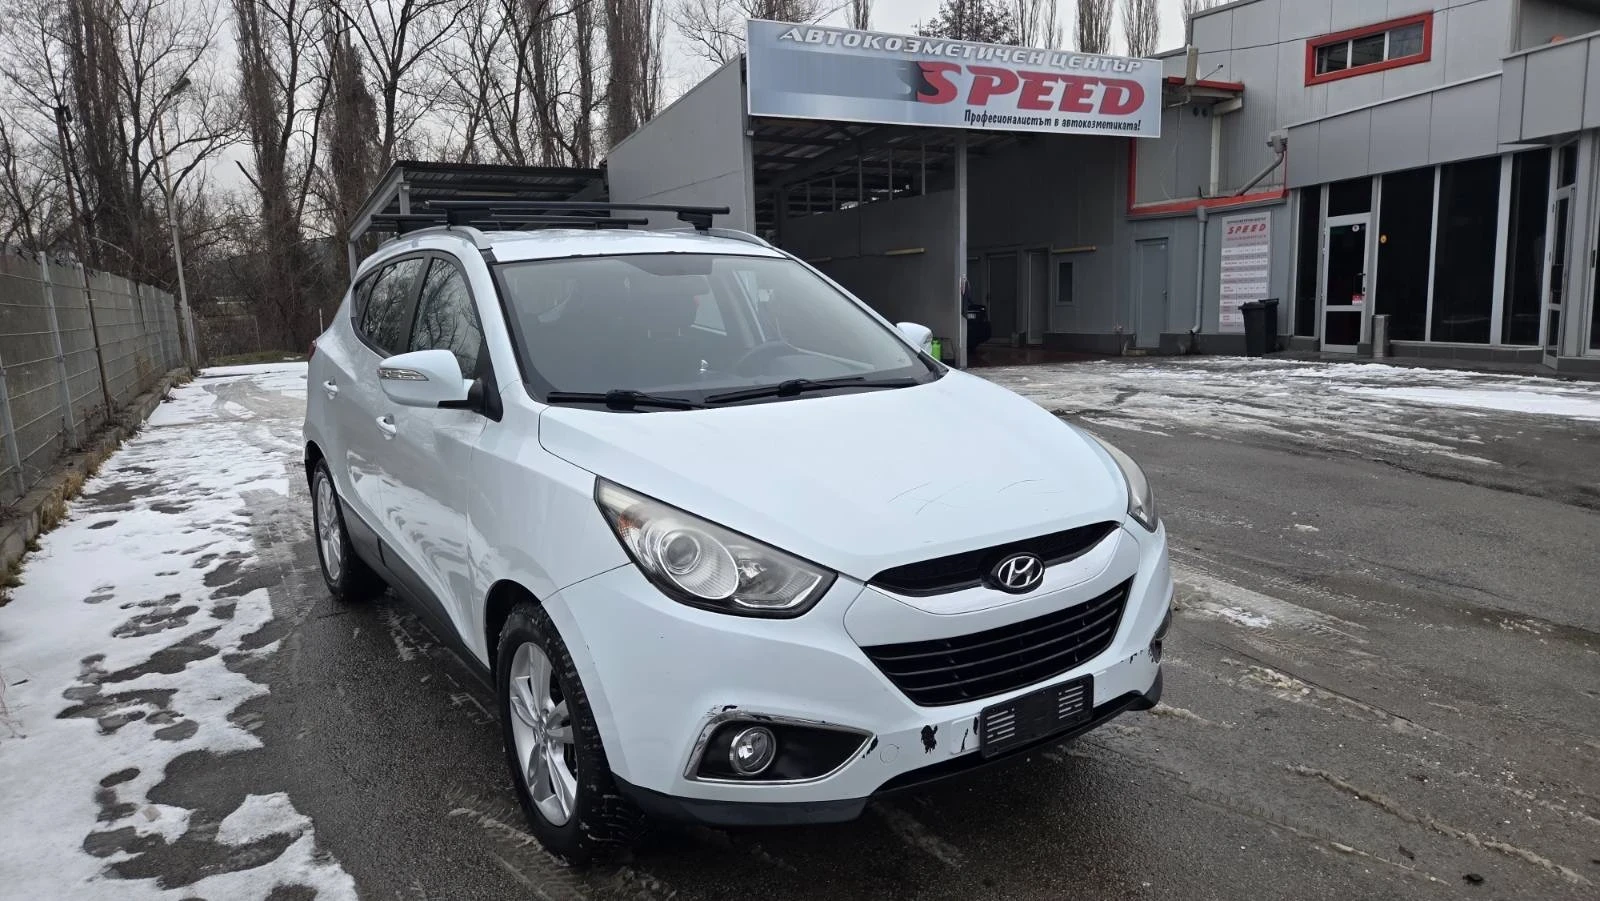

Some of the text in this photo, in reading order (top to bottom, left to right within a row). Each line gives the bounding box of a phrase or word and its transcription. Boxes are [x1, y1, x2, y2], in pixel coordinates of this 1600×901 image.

[778, 27, 1142, 73] АВТОКОЗМЕТИЧЕН ЦЕНТЪР
[916, 60, 1145, 116] SPEED
[964, 109, 1142, 131] Професионалистът в автокозметиката!
[1227, 223, 1266, 235] SPEED
